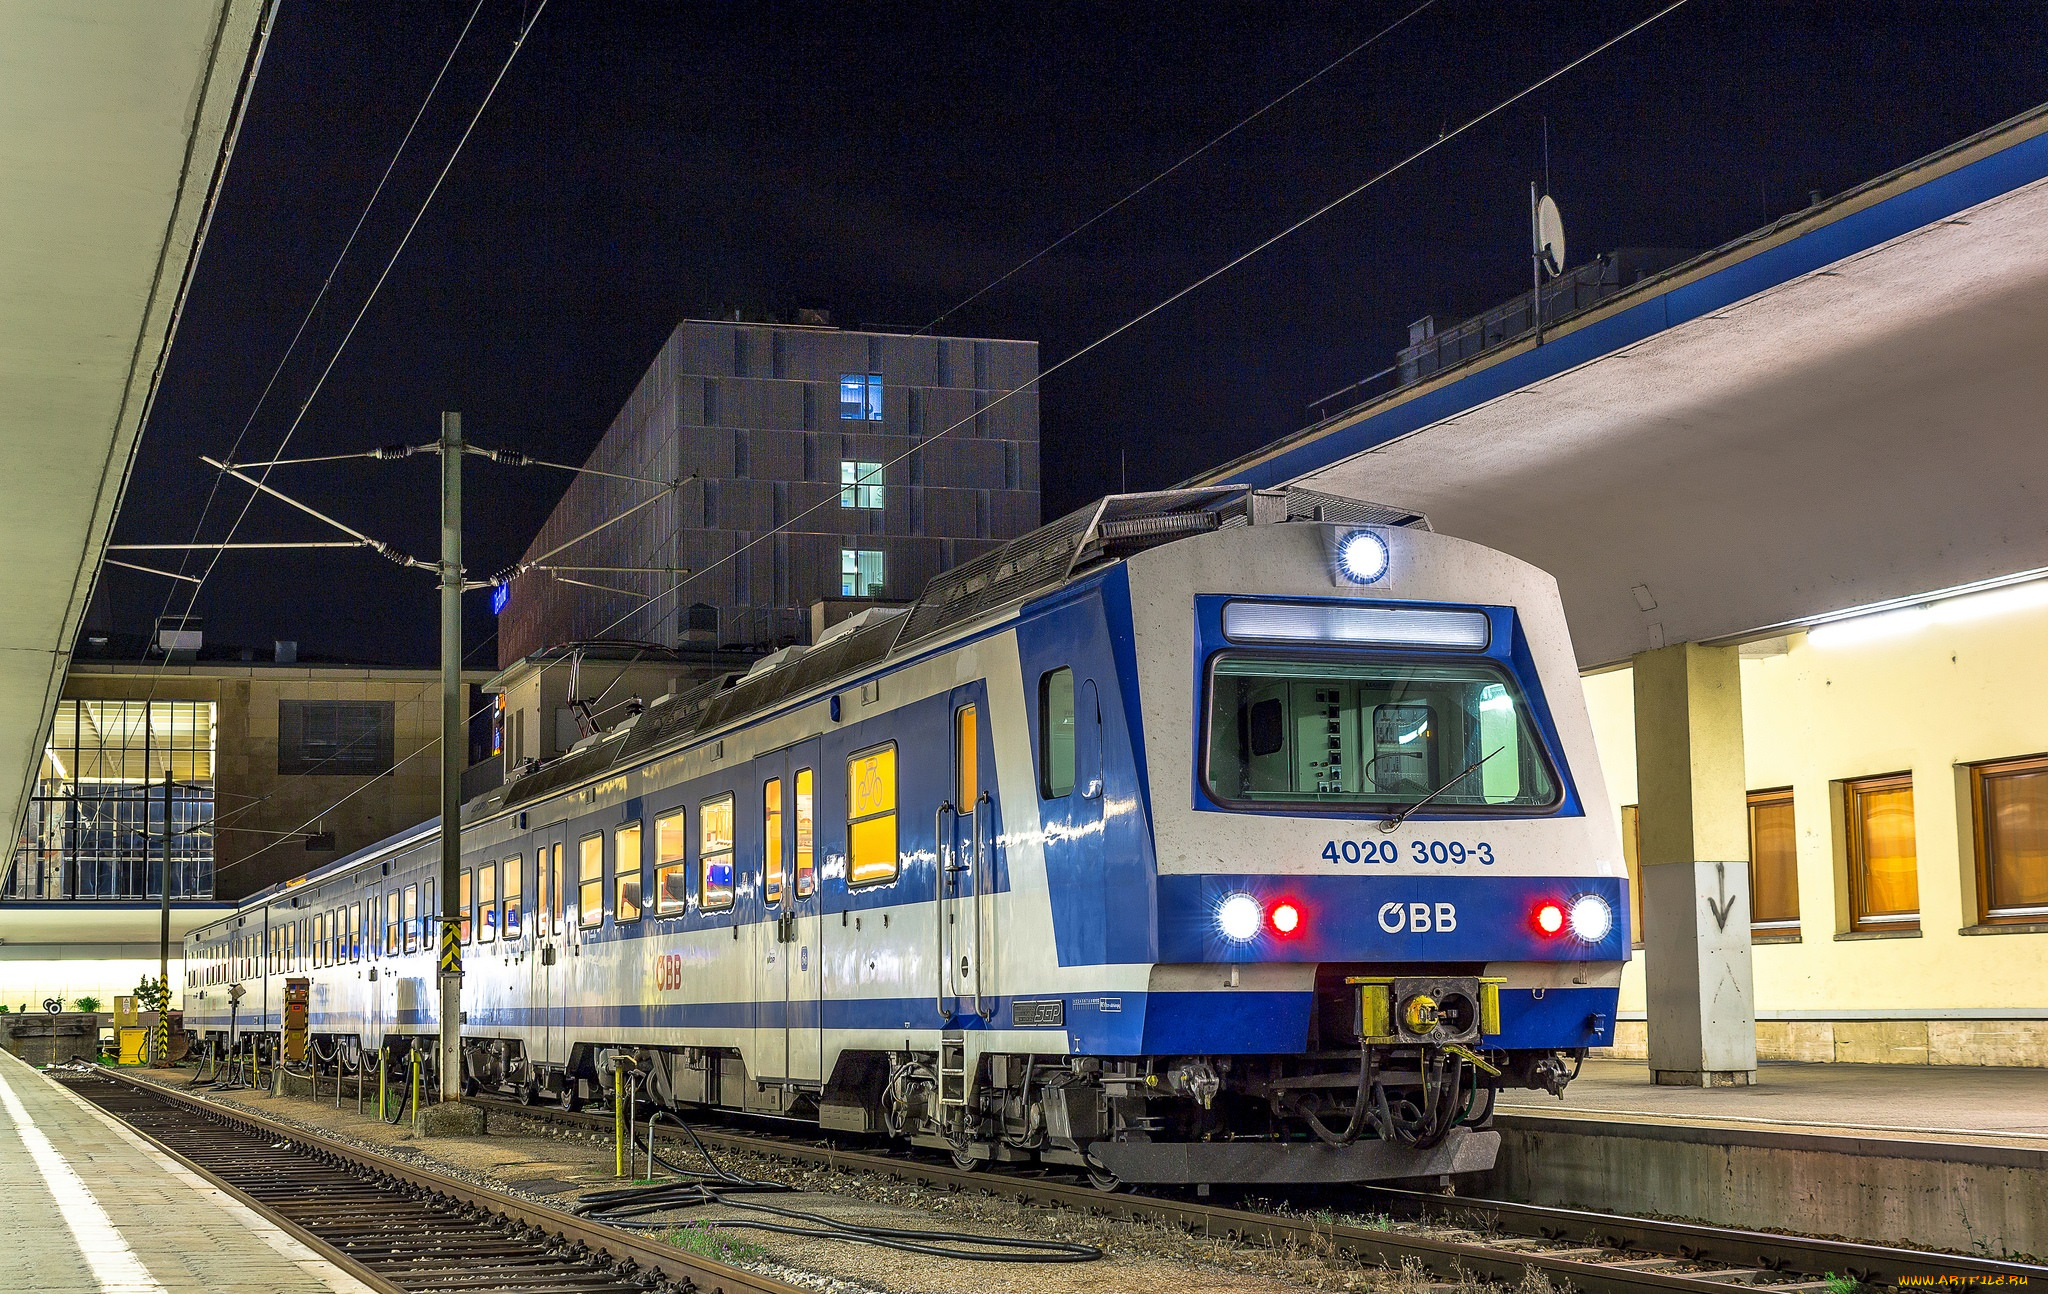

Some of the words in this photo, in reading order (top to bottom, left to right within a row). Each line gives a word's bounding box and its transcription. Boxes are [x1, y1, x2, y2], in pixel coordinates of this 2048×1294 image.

[1321, 840, 1398, 864] 4020
[1410, 840, 1495, 866] 309-3
[1377, 902, 1457, 934] ÖBB
[655, 954, 682, 992] ÖBB
[1034, 1004, 1061, 1022] SGP
